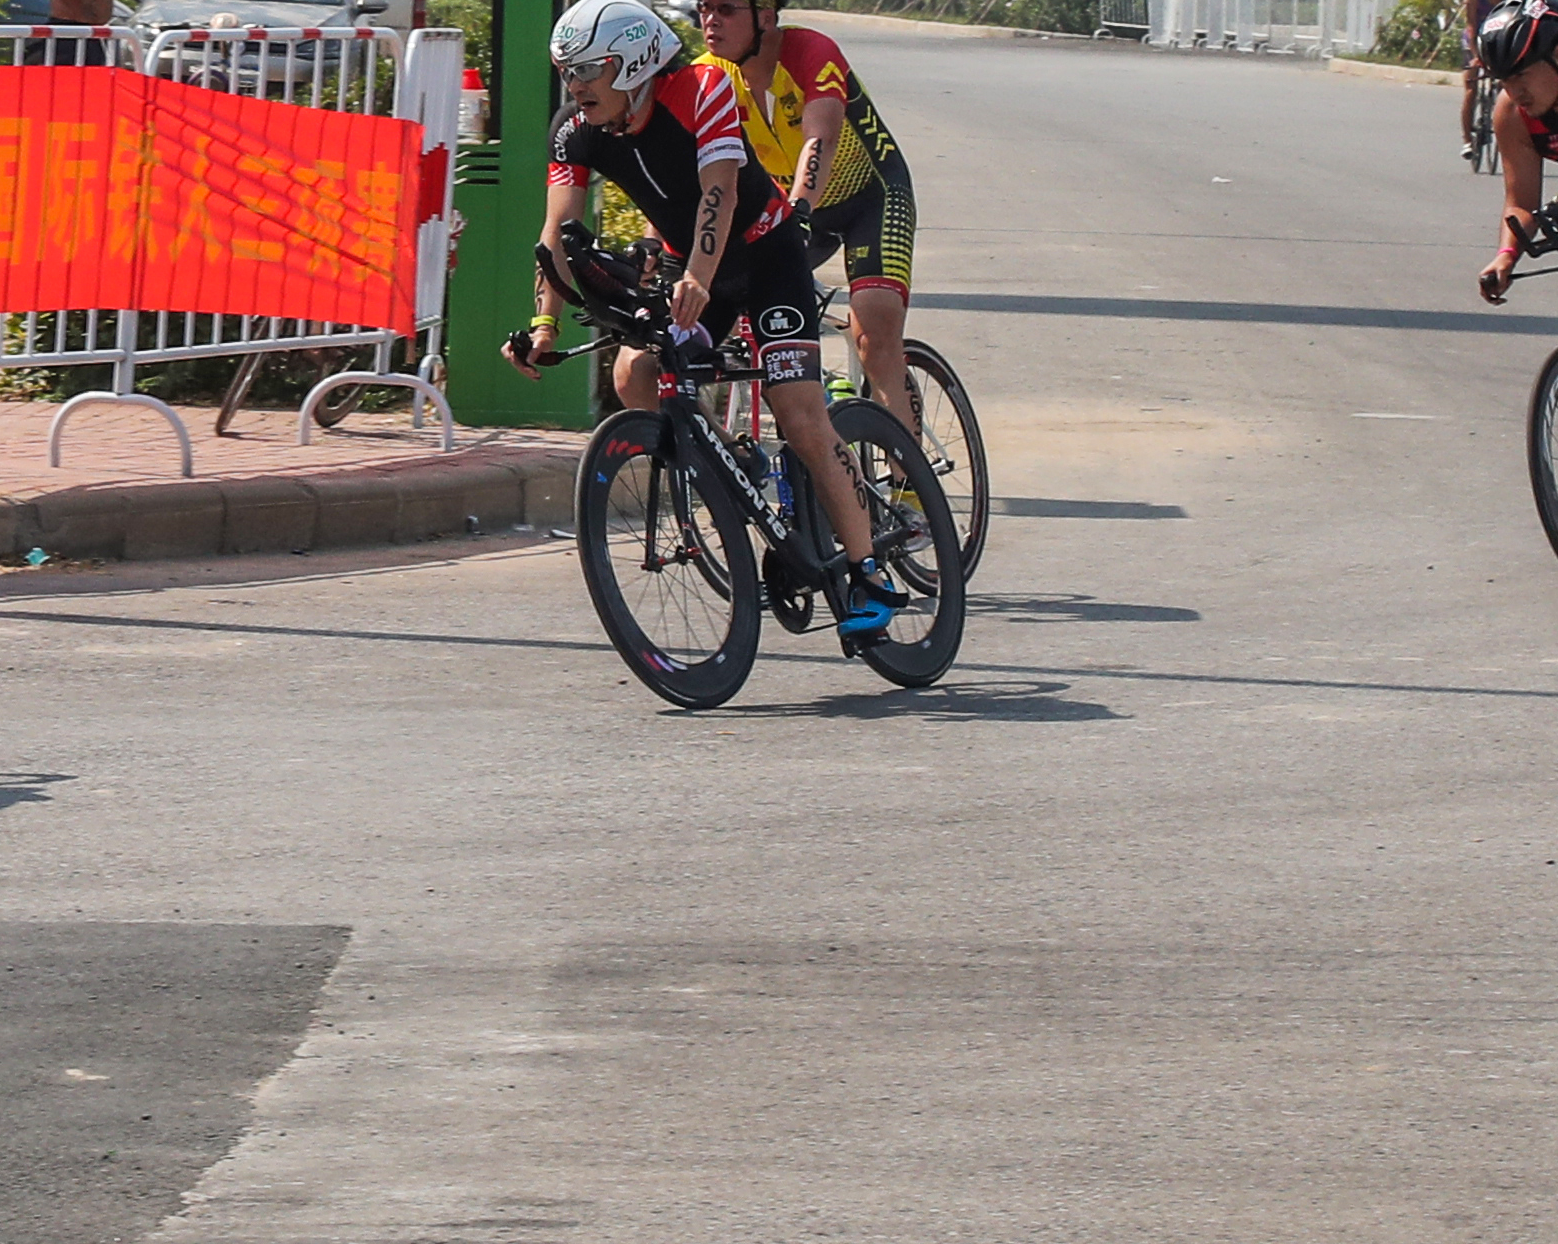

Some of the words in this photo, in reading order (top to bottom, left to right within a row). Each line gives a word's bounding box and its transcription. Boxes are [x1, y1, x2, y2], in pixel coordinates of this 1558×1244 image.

[624, 23, 648, 43] 520
[804, 138, 822, 190] 463
[699, 184, 723, 256] 520
[833, 443, 869, 510] 520
